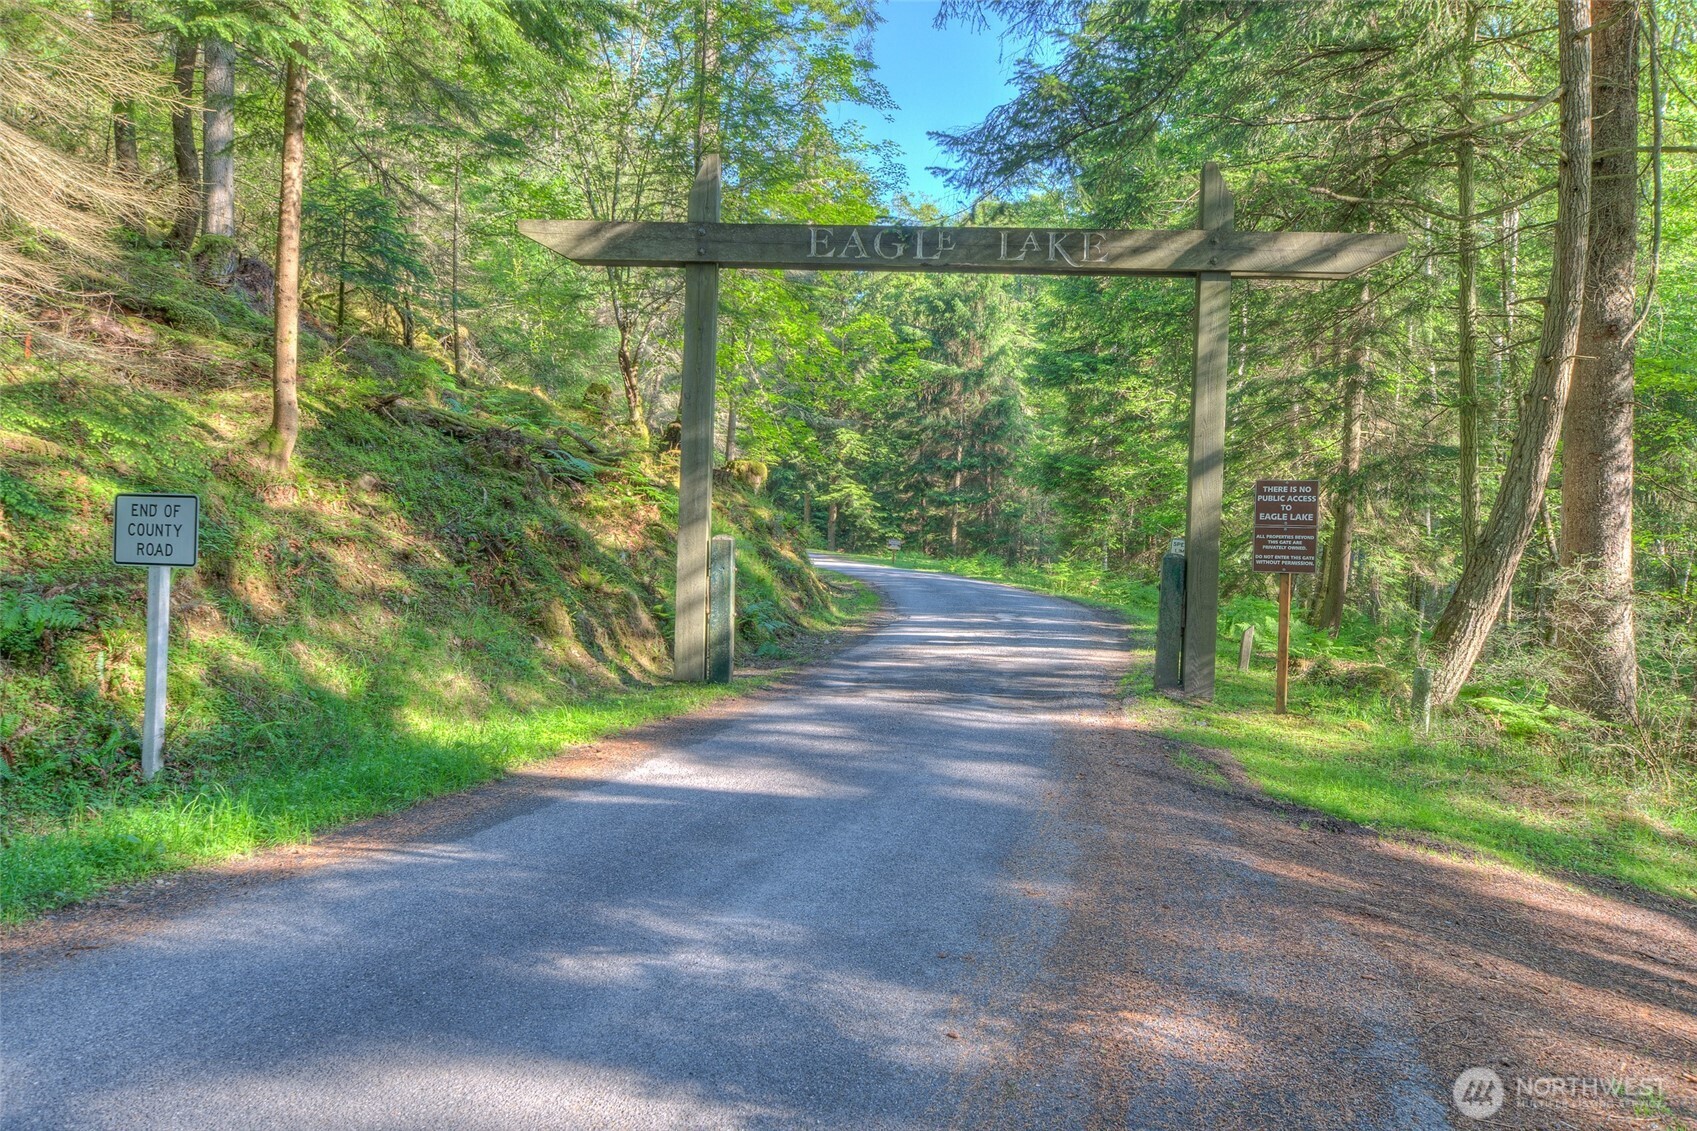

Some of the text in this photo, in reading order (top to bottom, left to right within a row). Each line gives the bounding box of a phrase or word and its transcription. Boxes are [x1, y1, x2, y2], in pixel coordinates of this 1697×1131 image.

[806, 227, 1110, 268] EAGLE LAKE
[1257, 494, 1317, 503] PUBLIC ACCESS
[131, 503, 181, 518] END OF
[1259, 512, 1314, 521] EAGLE LAKE
[128, 523, 183, 537] COUNTY
[136, 542, 174, 557] ROAD
